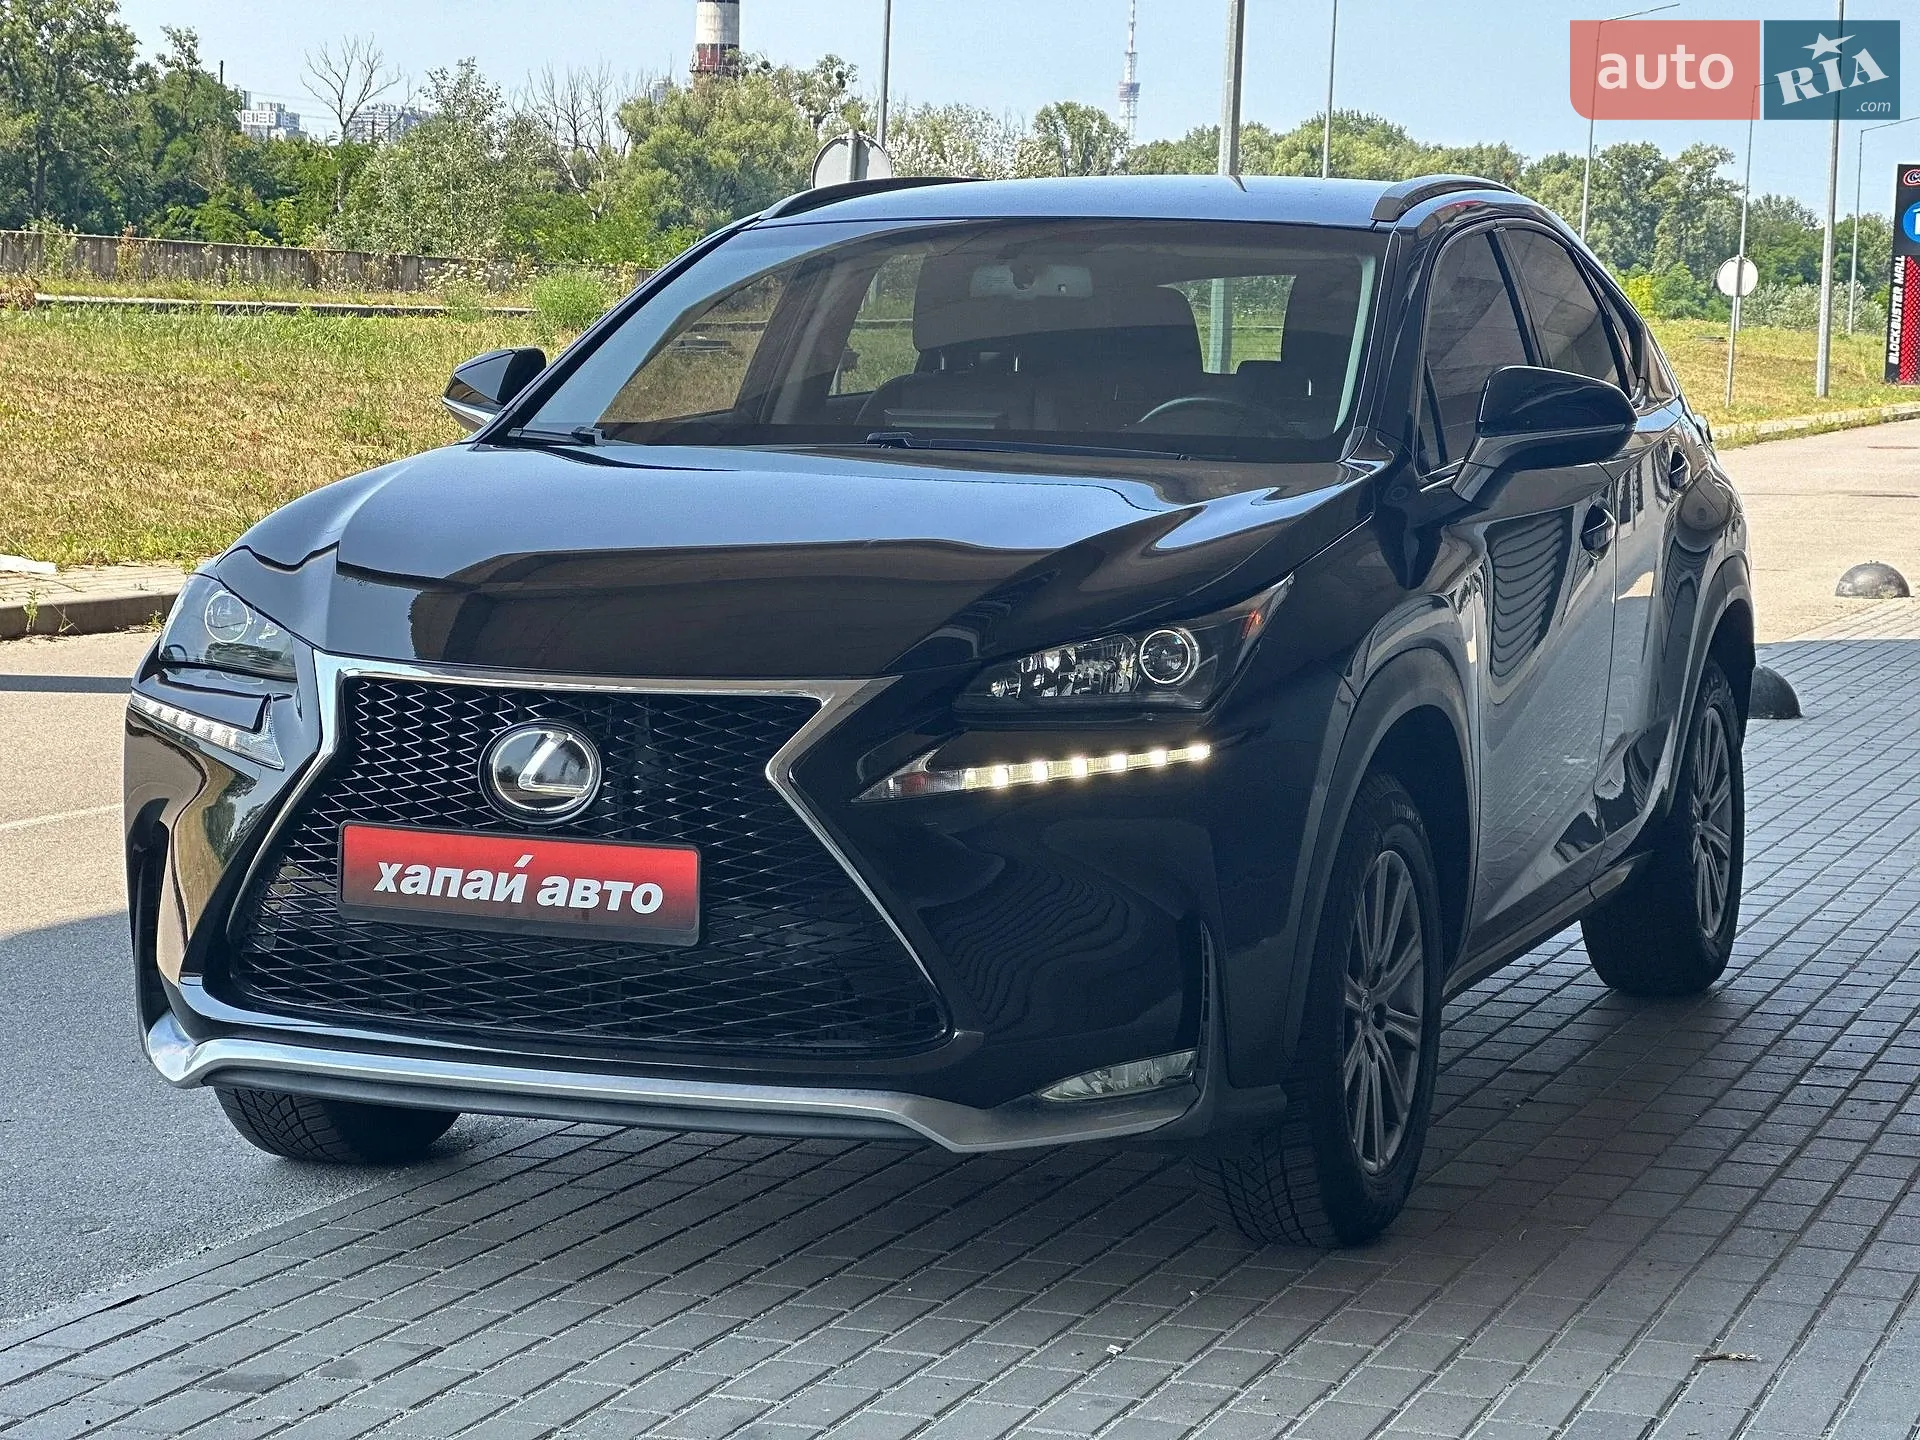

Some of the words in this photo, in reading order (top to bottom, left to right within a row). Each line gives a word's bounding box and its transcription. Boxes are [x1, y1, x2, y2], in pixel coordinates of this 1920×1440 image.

[1893, 254, 1906, 285] MALL
[1888, 286, 1904, 365] BLOCKBUSTER
[536, 875, 664, 914] авто
